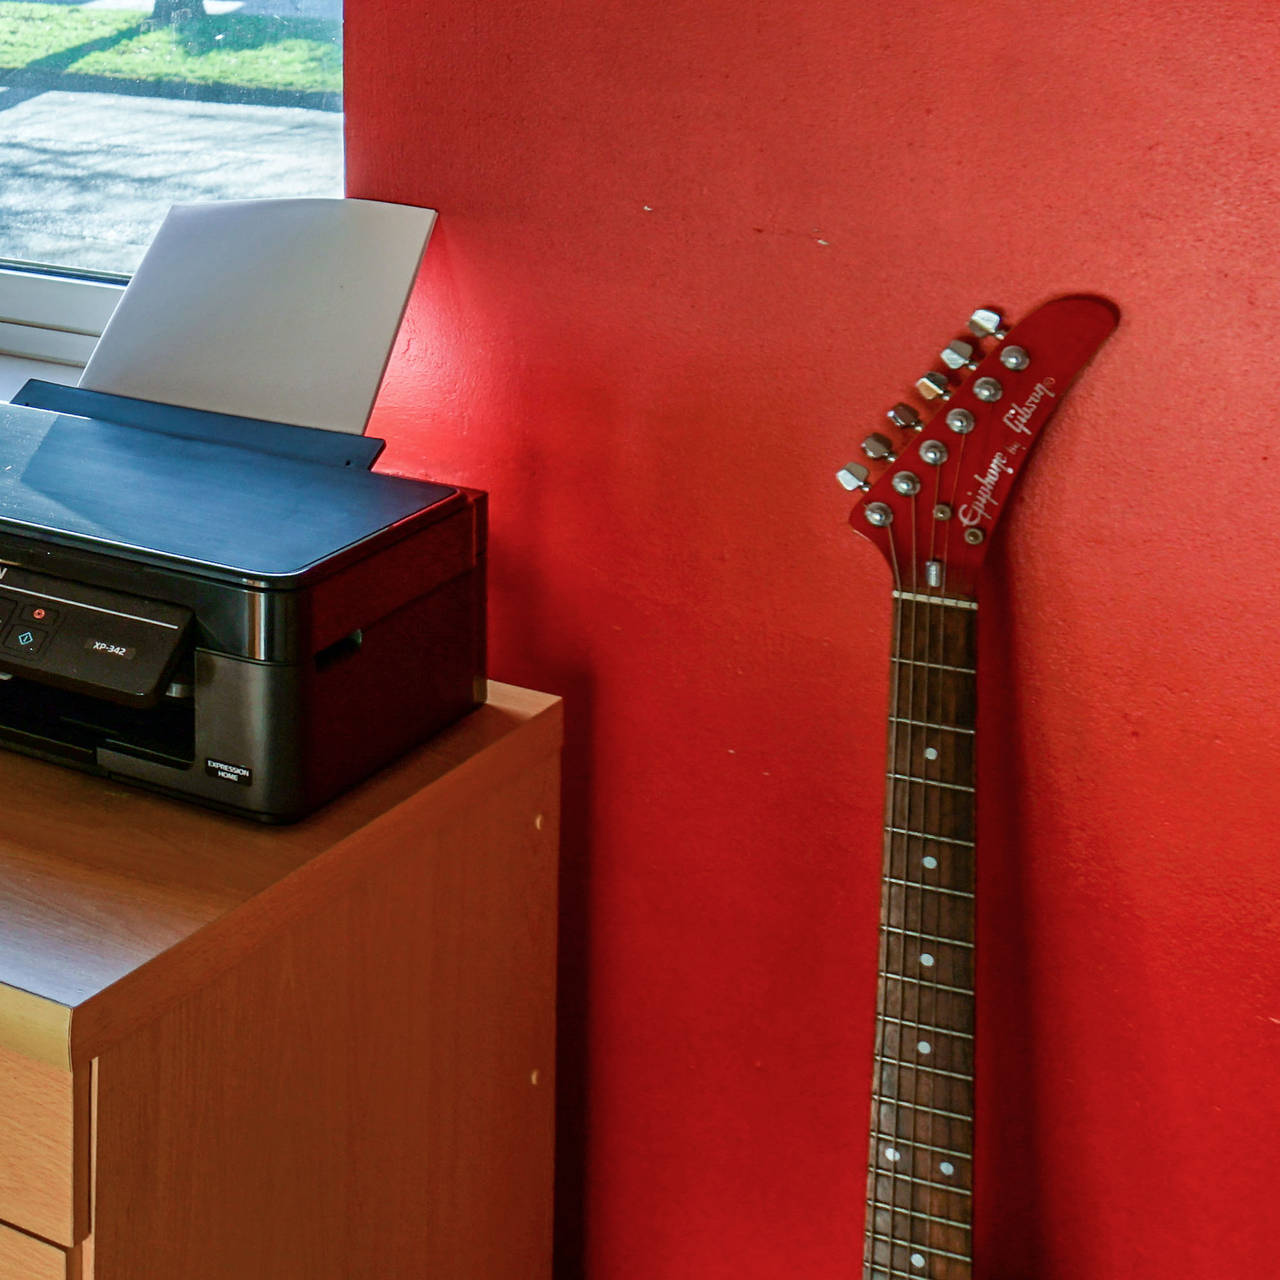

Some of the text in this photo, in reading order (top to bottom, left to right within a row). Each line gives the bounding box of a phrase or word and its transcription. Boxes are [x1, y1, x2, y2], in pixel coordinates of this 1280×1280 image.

[1002, 382, 1056, 435] Gibson
[91, 640, 128, 657] XP-342
[207, 760, 250, 777] EXPRESSION
[217, 770, 239, 781] HOME
